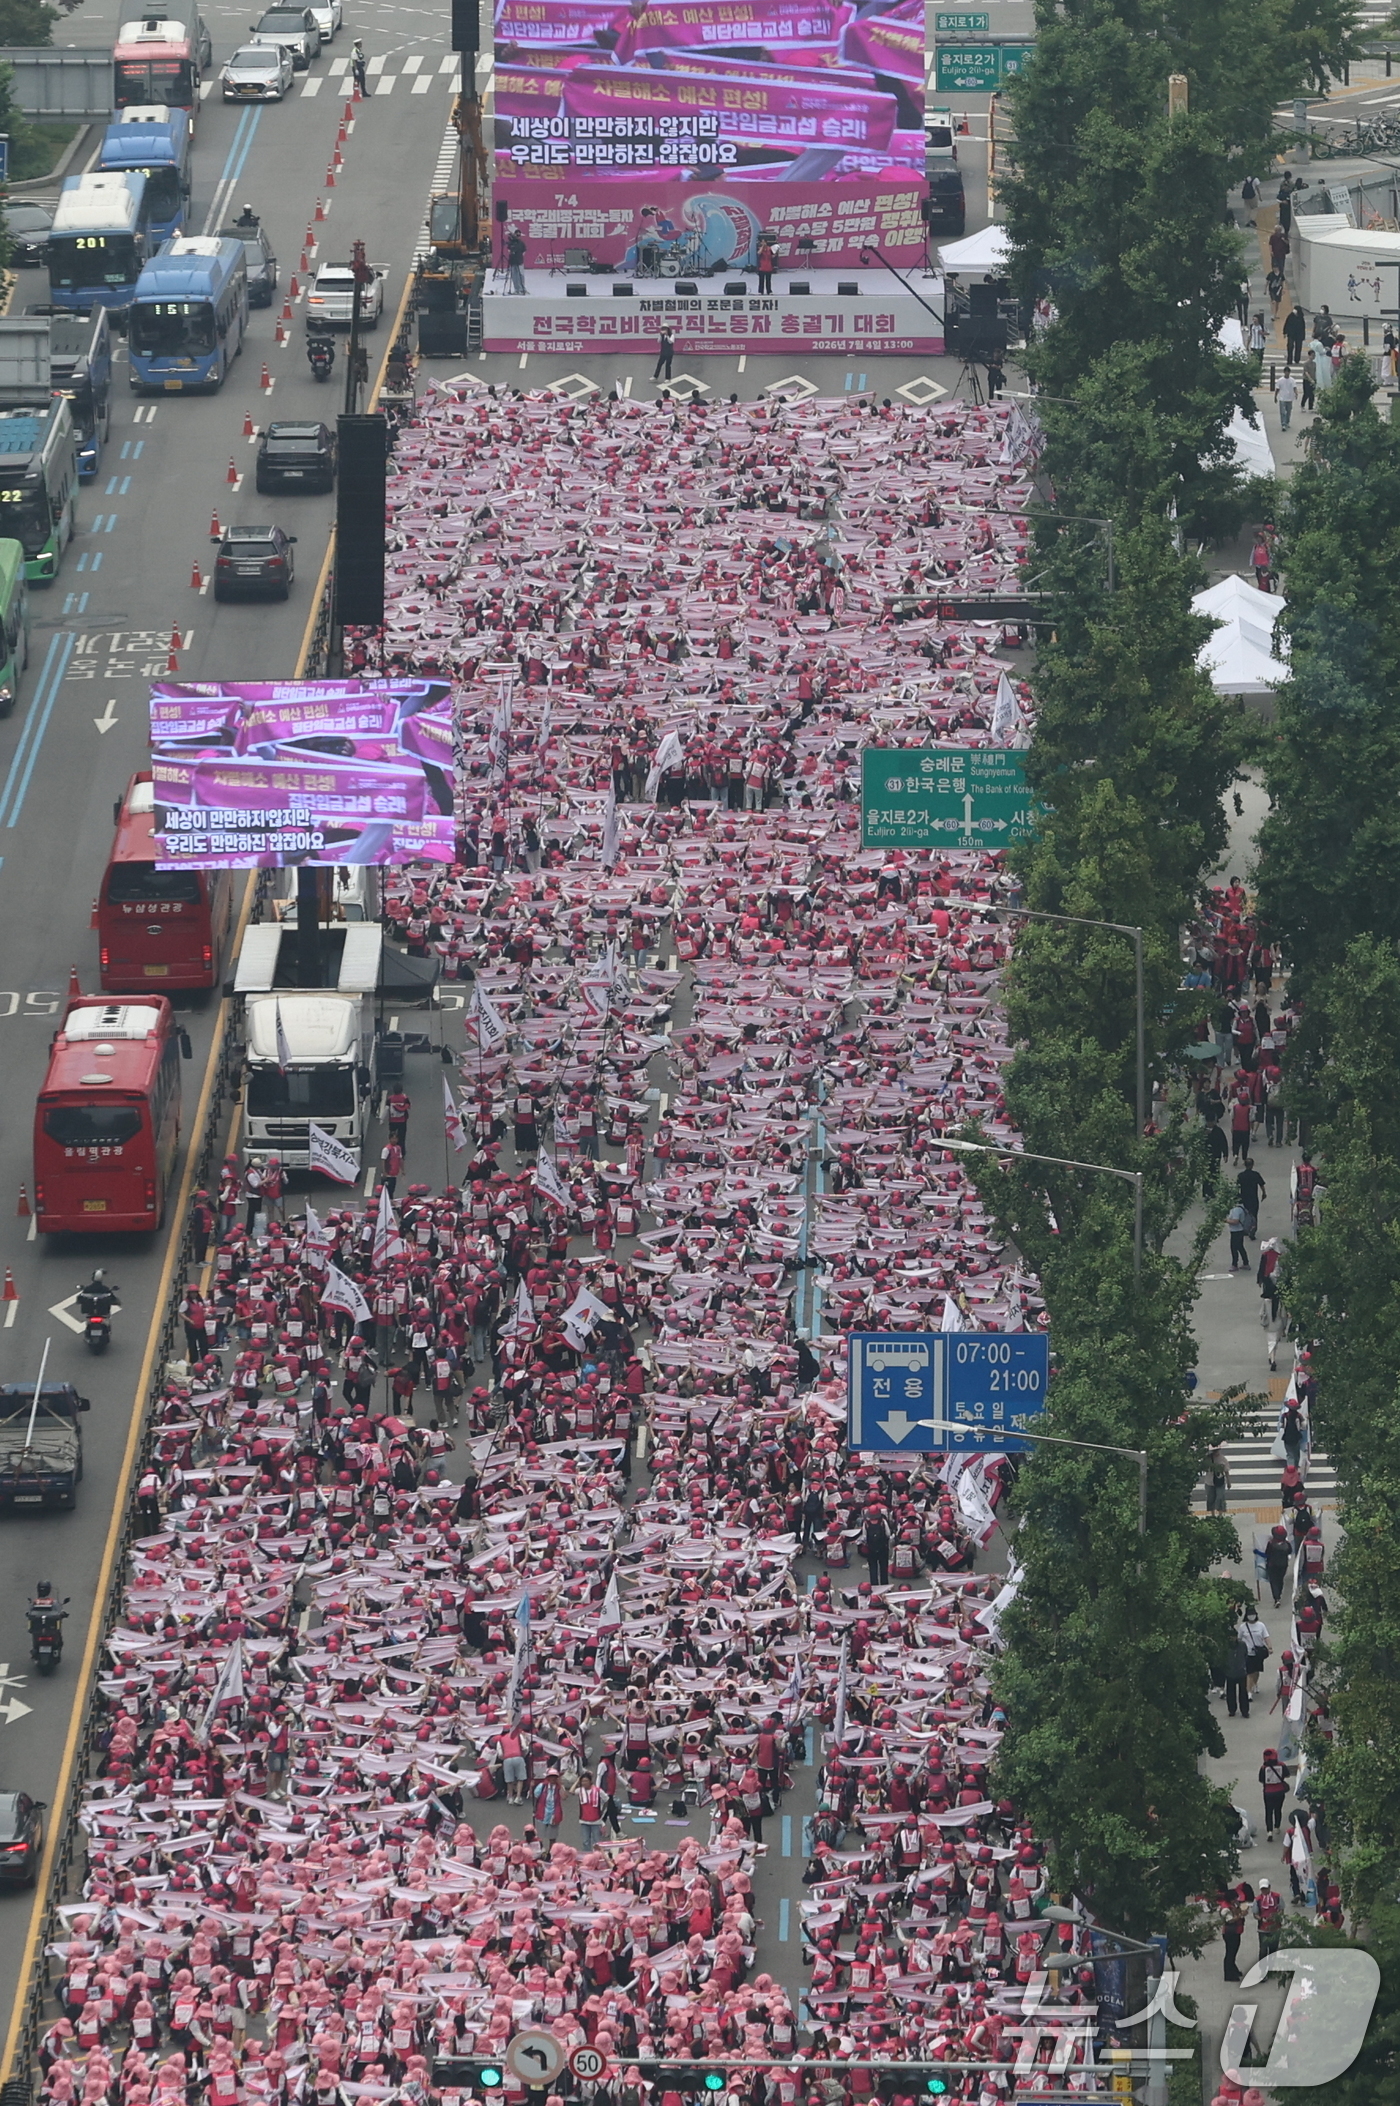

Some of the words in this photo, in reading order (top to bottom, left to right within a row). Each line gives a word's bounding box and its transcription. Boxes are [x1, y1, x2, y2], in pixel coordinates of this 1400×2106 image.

[939, 16, 986, 28] 을지로1가
[941, 53, 995, 65] 을지로2가
[942, 67, 967, 75] Euljiro
[511, 116, 570, 138] 세상이
[575, 116, 653, 138] 만만하지
[659, 116, 718, 138] 않지만
[511, 143, 570, 165] 우리도
[575, 143, 653, 165] 만만하진
[659, 143, 737, 165] 않잖아요
[769, 203, 833, 222] 차별해소
[837, 199, 871, 216] 예산
[874, 191, 920, 212] 편성!
[506, 209, 634, 222] 국학교비정규직노동자
[832, 216, 877, 234] 5만원
[880, 210, 923, 229] 쟁취!
[528, 223, 572, 238] 총궐기
[575, 223, 605, 238] 대회
[76, 237, 105, 249] 201
[848, 233, 880, 249] 약속
[155, 304, 190, 315] 151
[640, 300, 702, 312] 차별철폐의
[707, 300, 743, 311] 포문을
[749, 300, 779, 311] 열자!
[533, 314, 772, 335] 전국학교비정규직노동자
[781, 313, 844, 334] 총궐기
[853, 313, 896, 334] 대회
[517, 341, 535, 351] 서울
[538, 341, 584, 352] 을지로입구
[812, 339, 846, 350] 2026년
[848, 340, 864, 350] 7월
[866, 340, 882, 350] 4일
[884, 340, 914, 350] 13:00
[920, 757, 966, 773] 숭례문
[970, 767, 1016, 778] Sungnyemun
[889, 780, 900, 790] 31
[906, 777, 966, 793] 한국은행
[971, 784, 984, 793] The
[985, 784, 1003, 793] Bank
[1004, 784, 1012, 793] of
[1013, 784, 1035, 794] Korea
[165, 810, 207, 830] 세상이
[210, 809, 266, 829] 만만하지
[268, 808, 311, 827] 않지만
[867, 809, 930, 825] 을지로2가
[946, 820, 957, 829] 60
[981, 820, 991, 829] 60
[165, 835, 208, 855] 우리도
[211, 834, 266, 853] 만만하진
[269, 832, 325, 852] 않잖아요
[957, 837, 984, 847] 150m
[990, 1369, 1040, 1391] 21:00
[577, 2055, 599, 2072] 50
